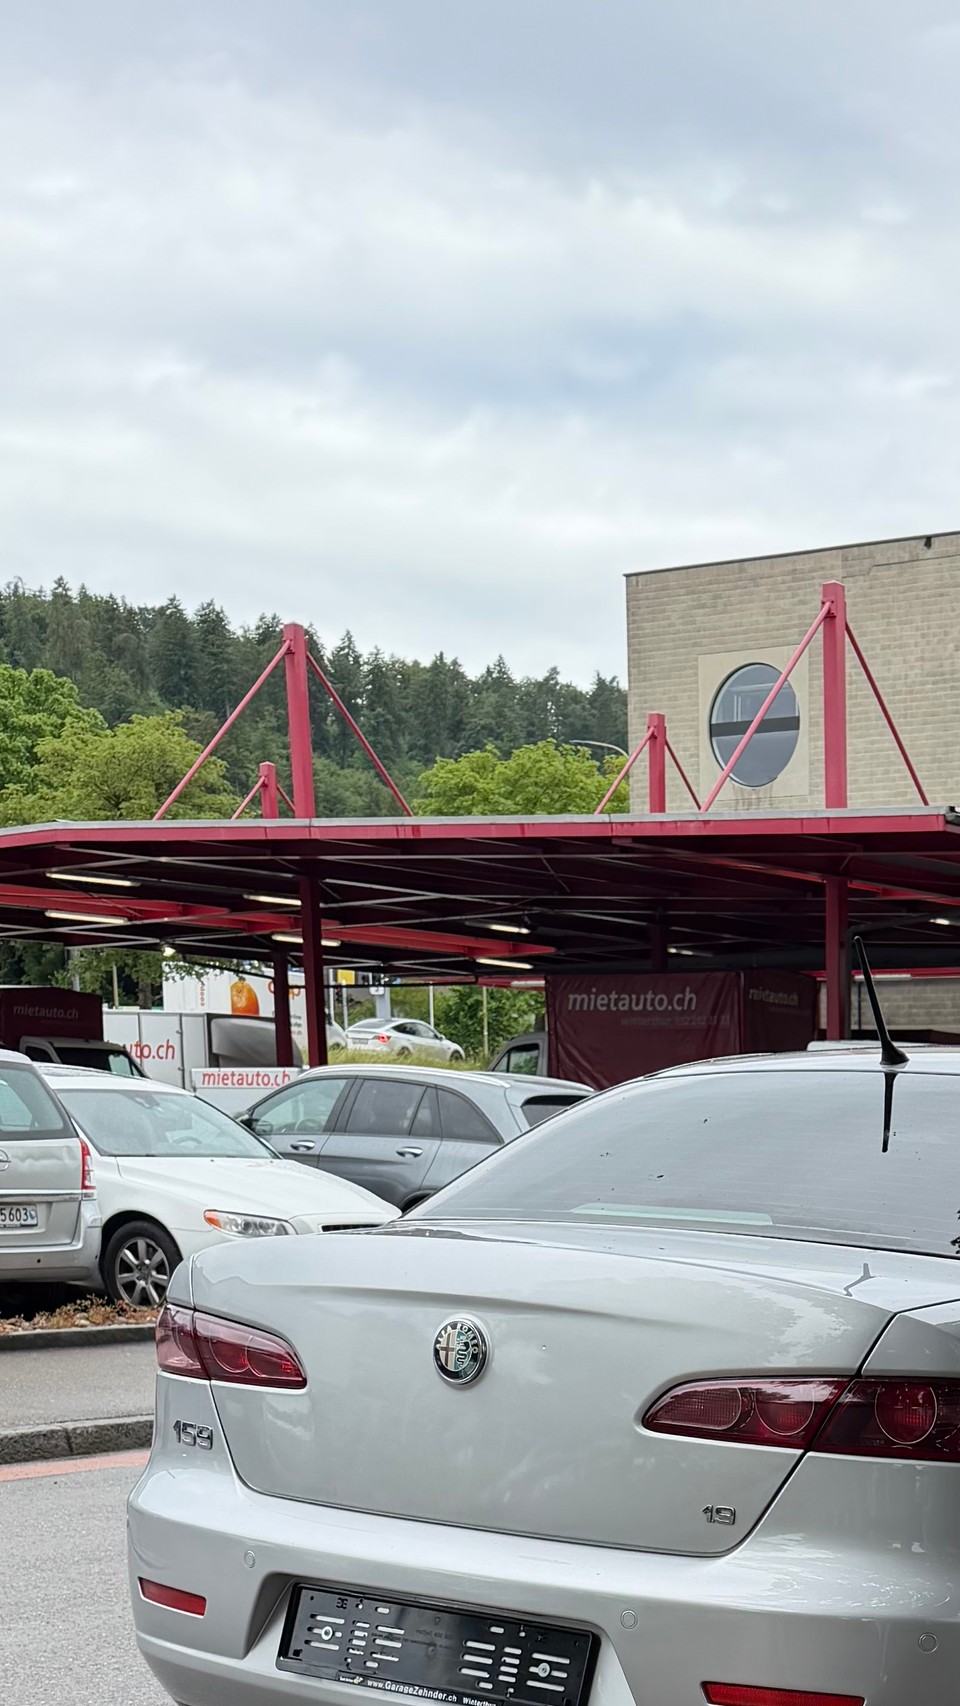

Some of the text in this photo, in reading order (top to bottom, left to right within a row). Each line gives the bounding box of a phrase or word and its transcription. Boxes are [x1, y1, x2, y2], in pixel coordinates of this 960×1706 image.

[568, 986, 697, 1012] mietauto.ch
[13, 1004, 79, 1019] mietauto.ch
[202, 1070, 291, 1087] mietauto.ch
[435, 1322, 479, 1354] ALFA ROMEO
[172, 1419, 213, 1451] 159
[367, 1680, 457, 1702] www.GarageZehnder.ch
